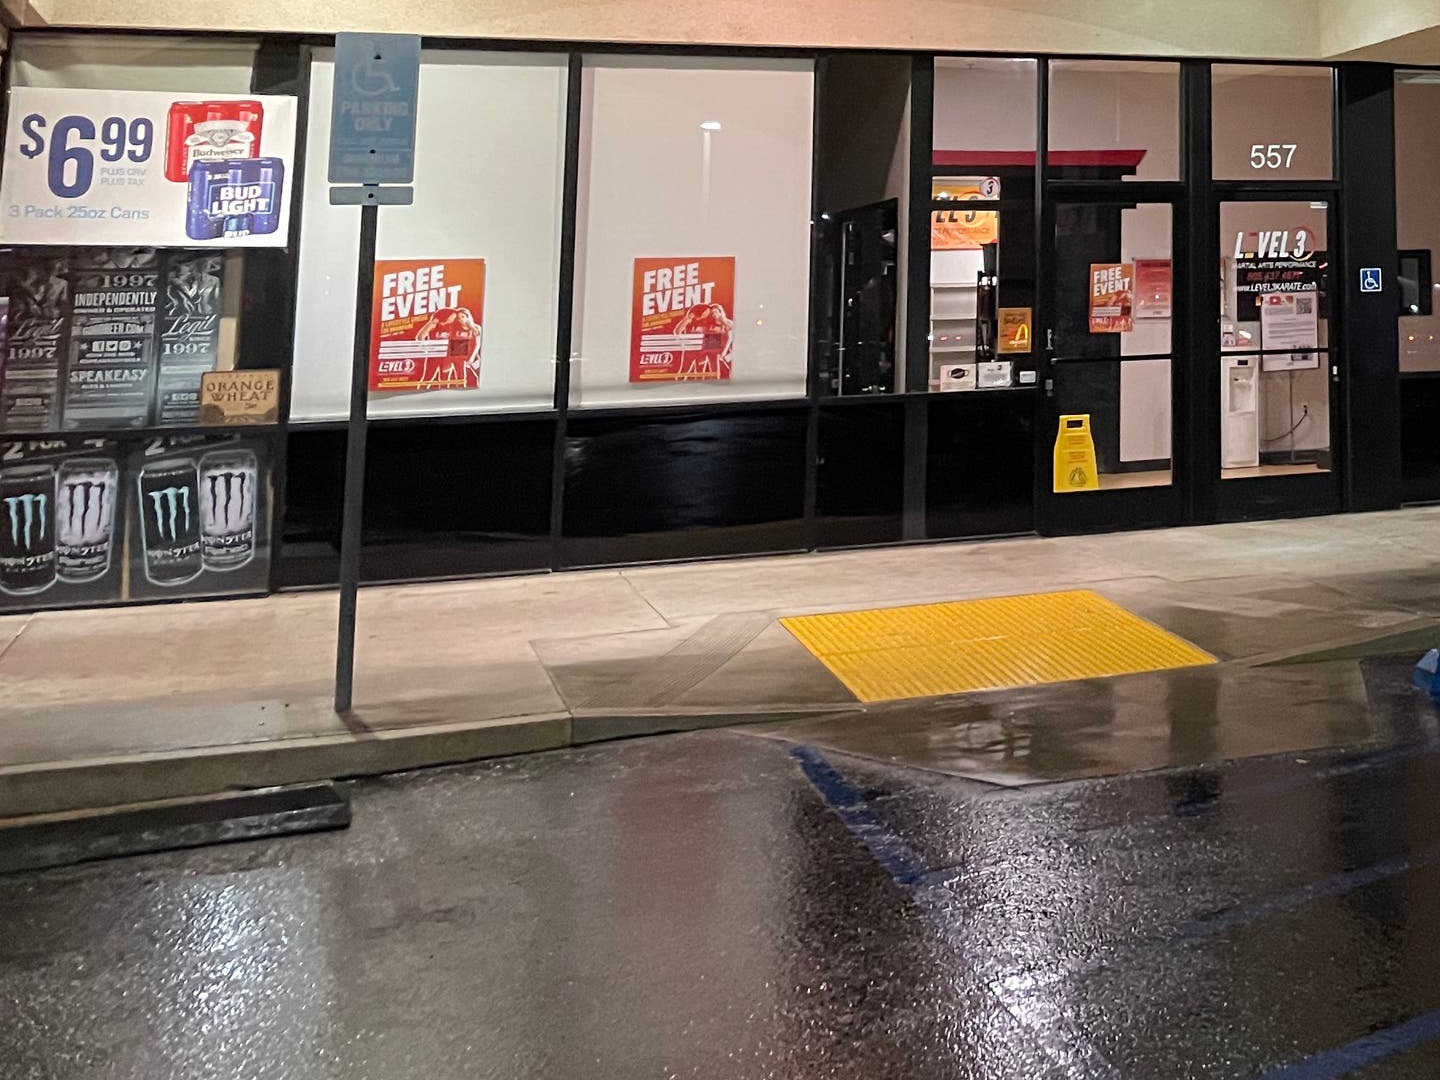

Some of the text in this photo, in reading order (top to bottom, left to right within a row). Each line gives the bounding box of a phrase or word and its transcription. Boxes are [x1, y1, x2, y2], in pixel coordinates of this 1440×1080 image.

[342, 100, 409, 117] PARKING
[193, 148, 245, 158] Budweiser
[1250, 145, 1298, 169] 557
[101, 167, 126, 177] PLUS
[101, 177, 146, 187] PLUS TAX
[220, 185, 263, 201] BUD
[9, 205, 151, 220] 3 Pack 25oz Cans
[211, 198, 271, 215] LIGHT
[1234, 230, 1307, 259] LEVEL 3
[102, 274, 158, 288] 1997
[382, 265, 445, 298] FREE
[643, 262, 699, 293] FREE
[1093, 266, 1122, 284] FREE
[1093, 277, 1131, 297] EVENT
[74, 291, 157, 307] INDEPENDENTLY
[380, 285, 462, 322] EVENT
[642, 281, 715, 317] EVENT
[162, 342, 211, 355] 1997
[70, 369, 147, 383] SPEAKEASY
[206, 380, 275, 393] ORANGE
[211, 390, 272, 402] WHEAT
